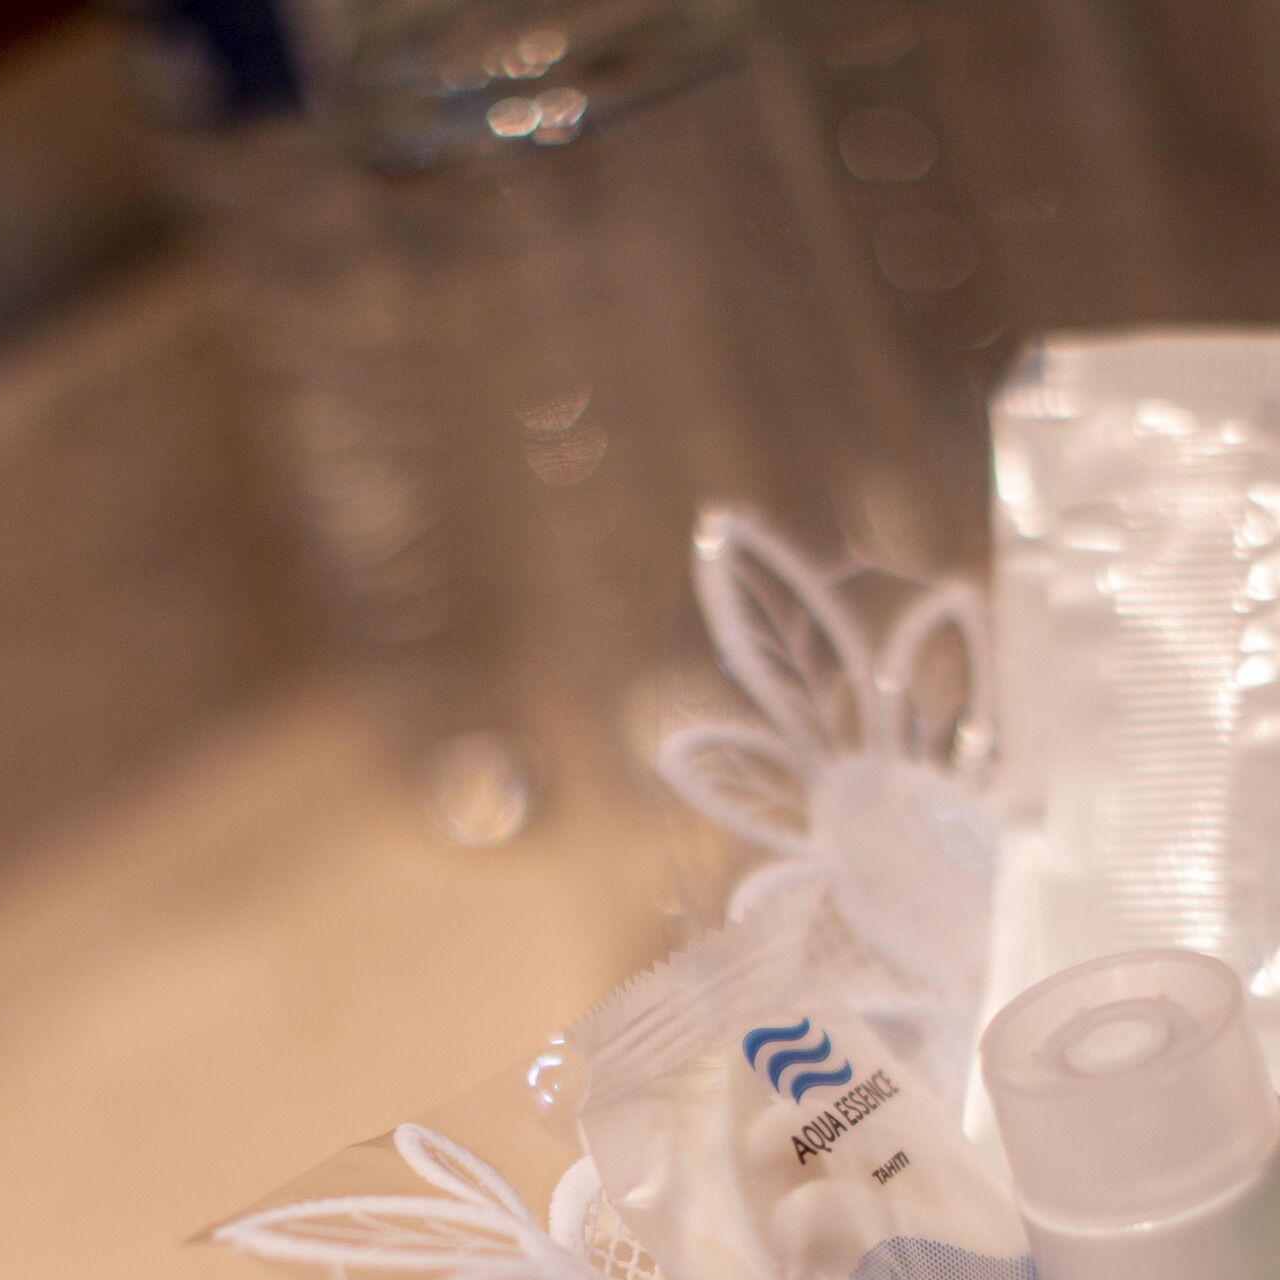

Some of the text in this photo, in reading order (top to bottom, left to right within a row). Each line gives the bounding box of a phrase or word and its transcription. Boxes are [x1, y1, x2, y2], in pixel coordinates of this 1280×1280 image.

[790, 1069, 900, 1166] AQUA ESSENCE
[871, 1150, 911, 1186] TAHITI
